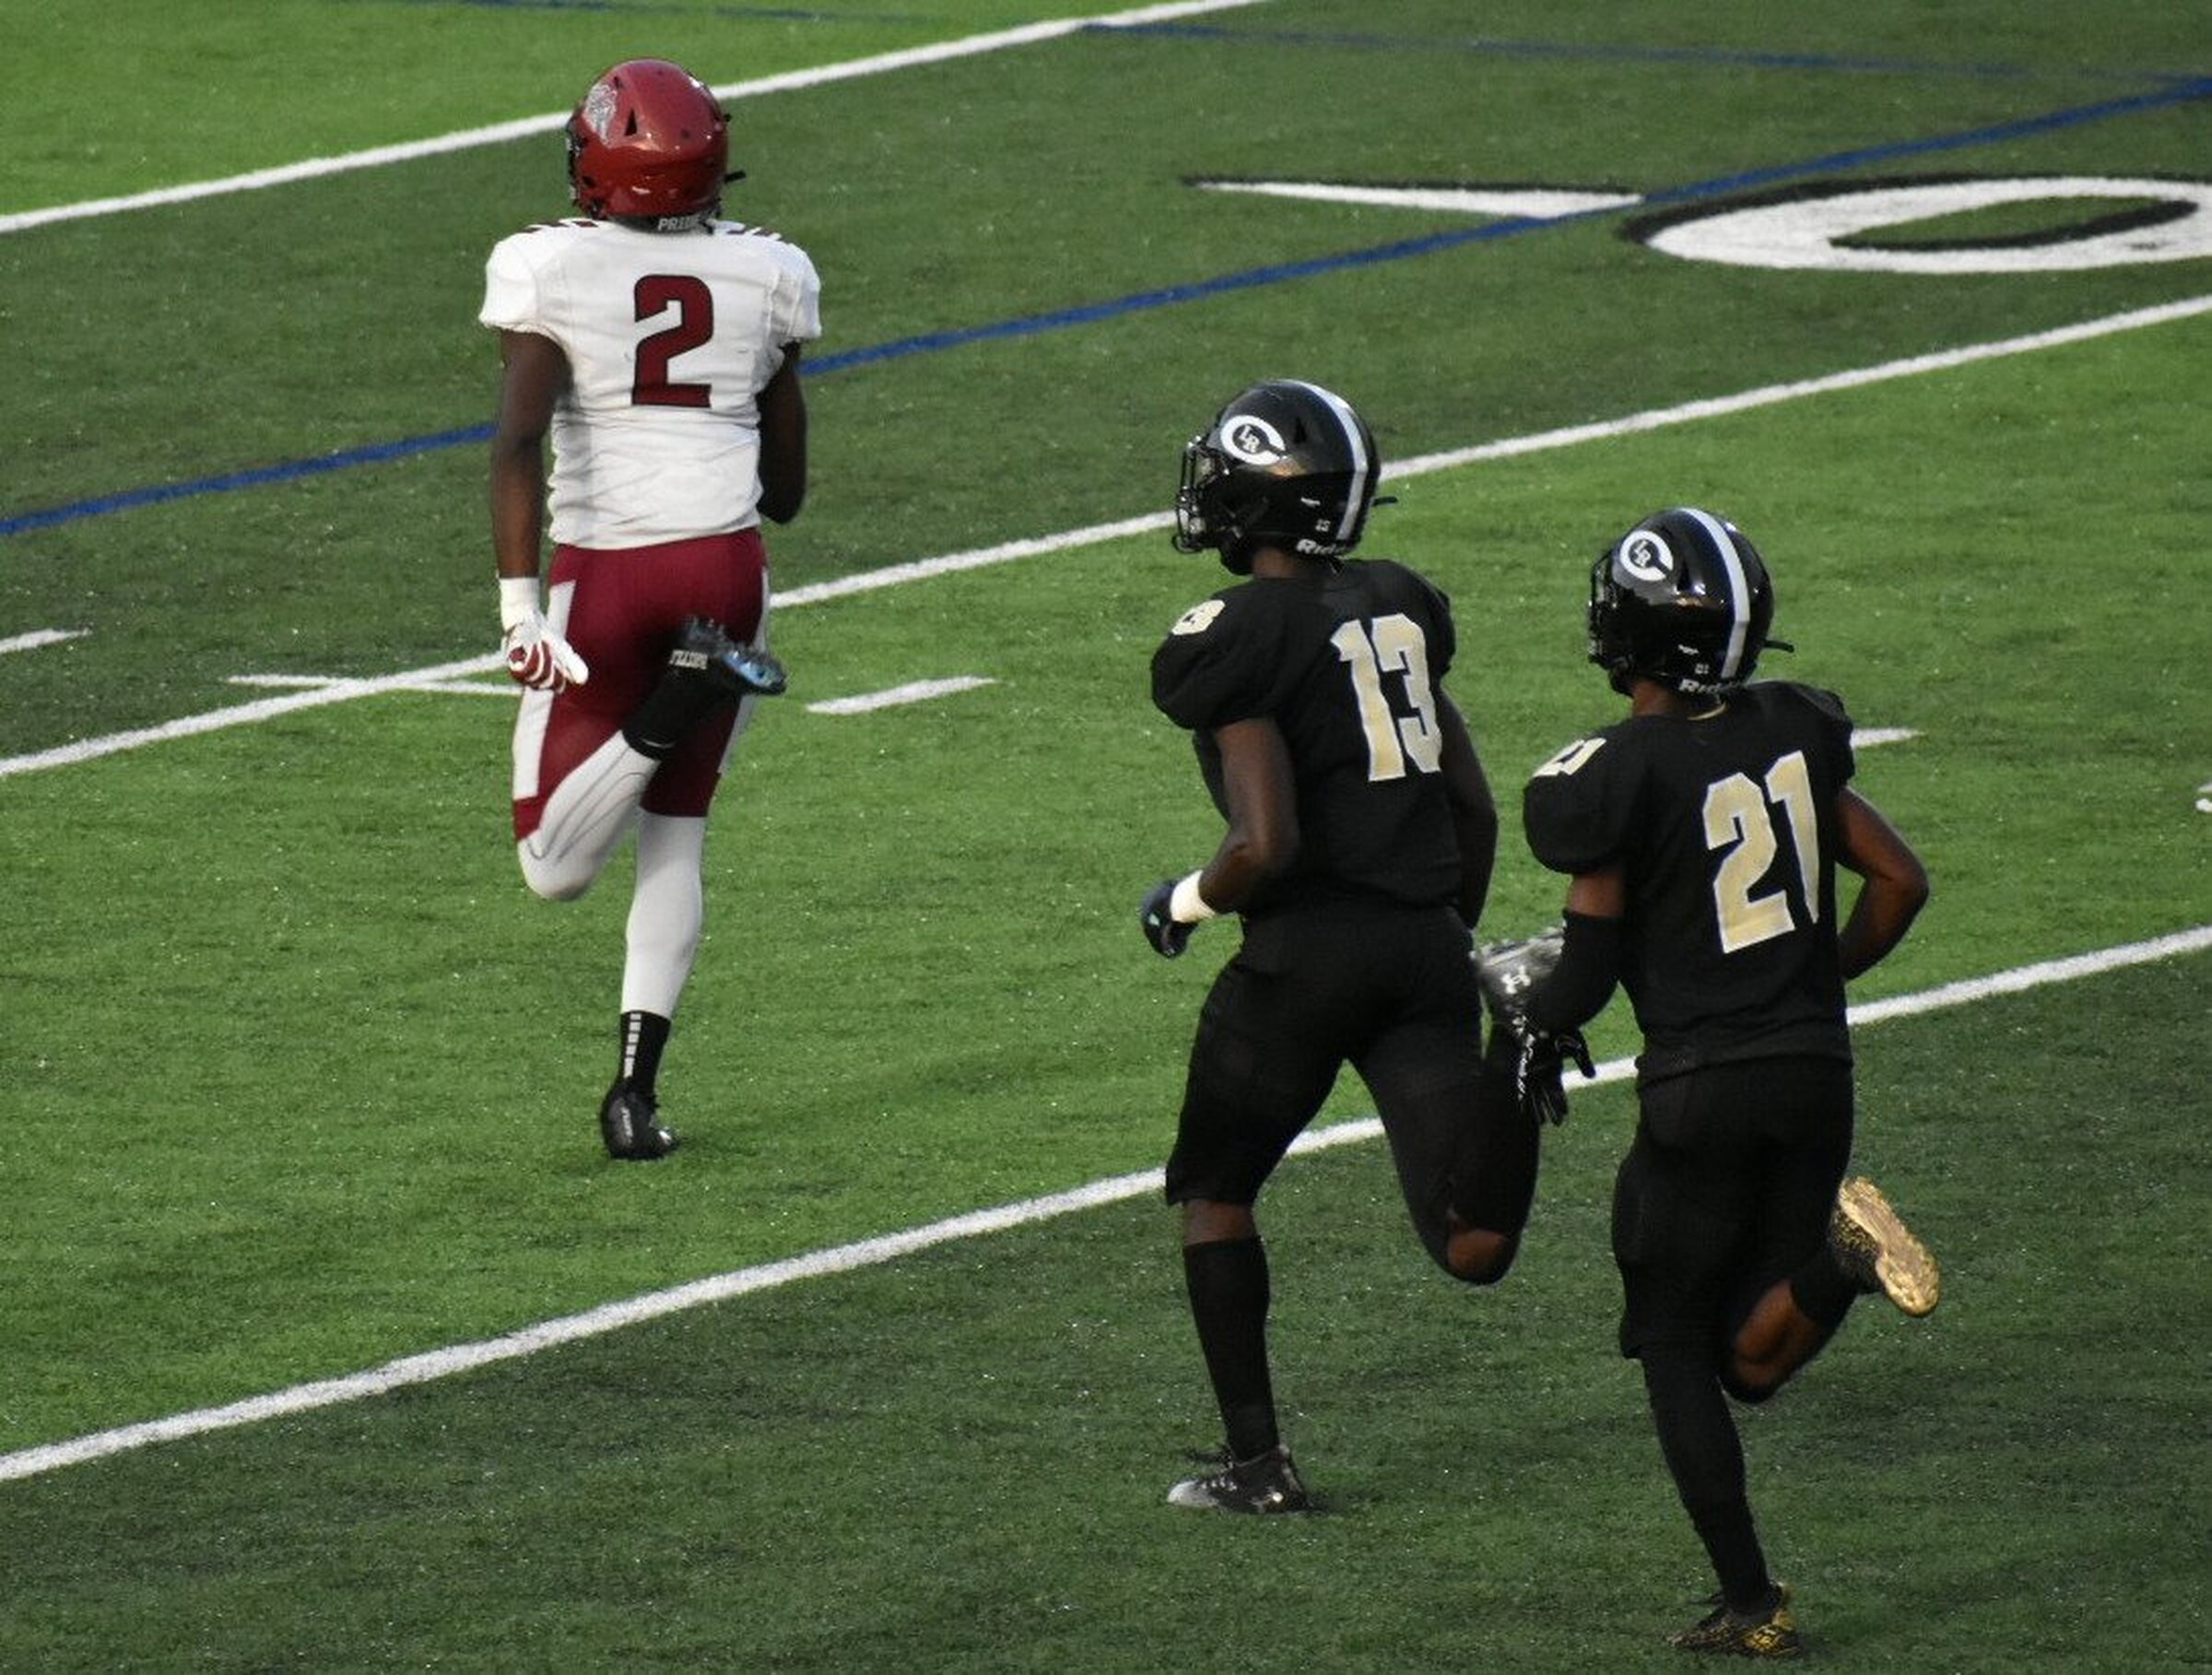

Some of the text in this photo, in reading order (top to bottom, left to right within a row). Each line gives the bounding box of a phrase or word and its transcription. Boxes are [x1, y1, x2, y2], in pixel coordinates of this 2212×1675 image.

[631, 274, 713, 408] 2
[1330, 612, 1443, 783] 13
[1701, 749, 1820, 955] 21
